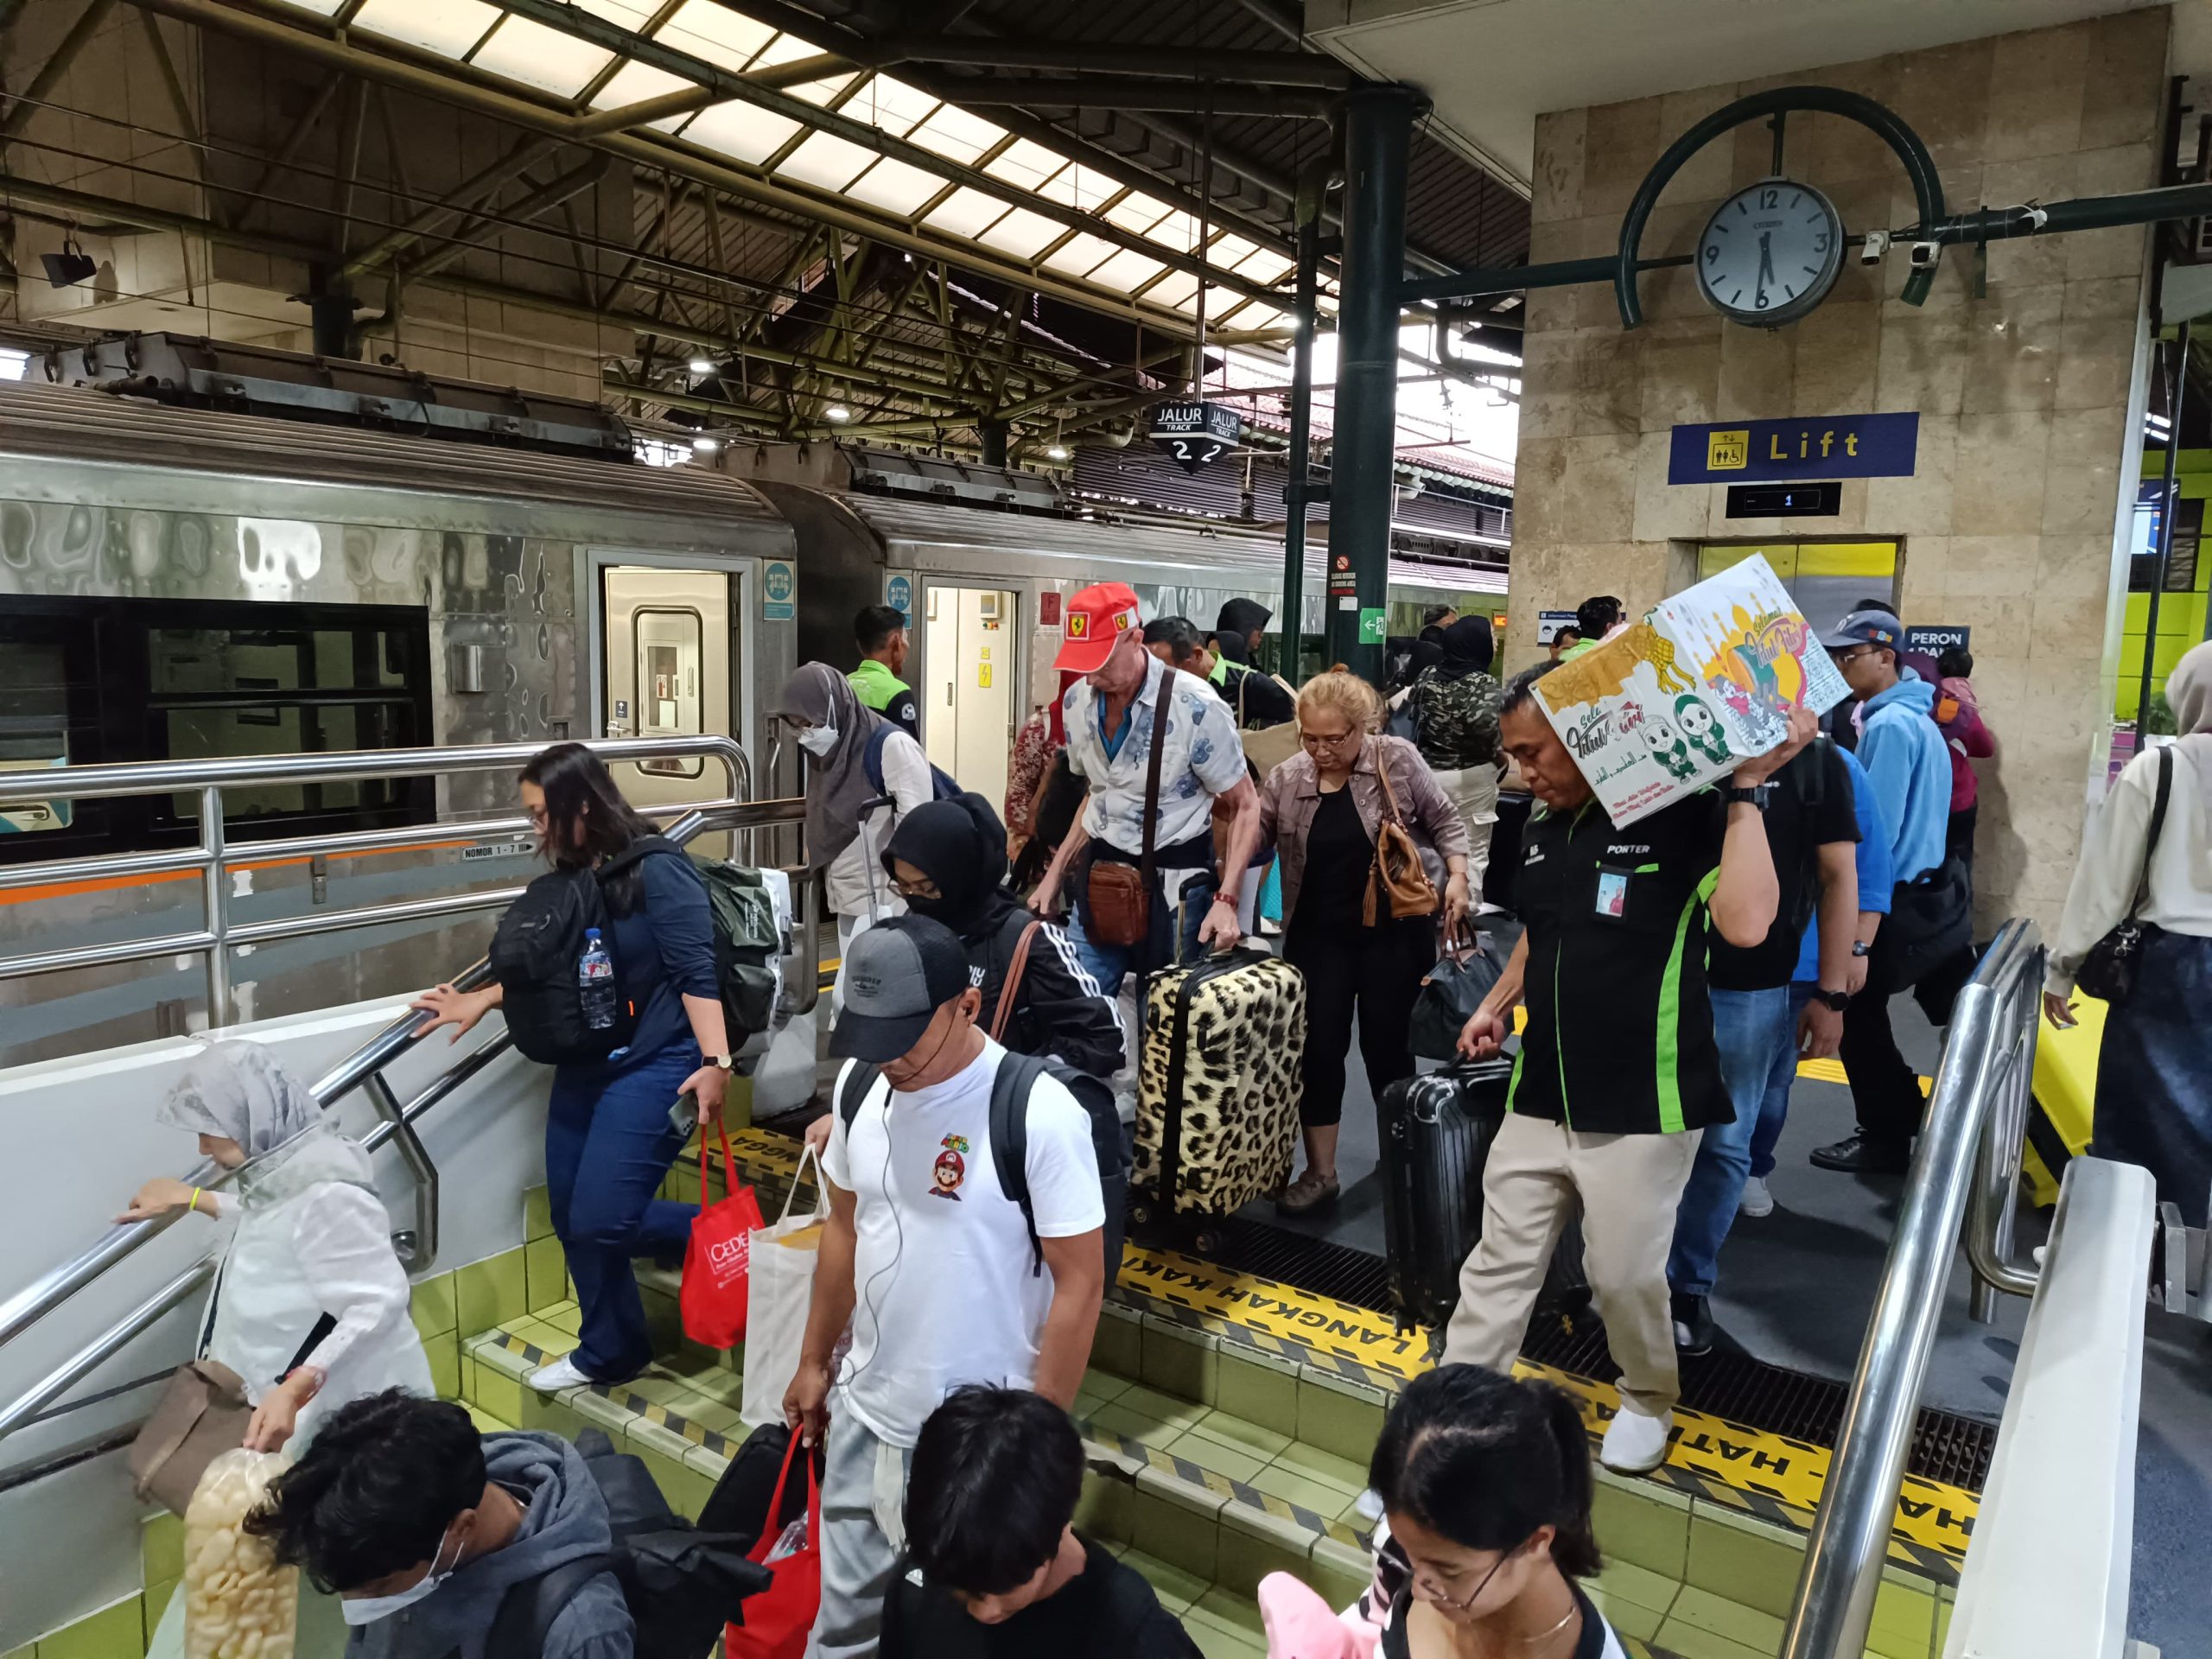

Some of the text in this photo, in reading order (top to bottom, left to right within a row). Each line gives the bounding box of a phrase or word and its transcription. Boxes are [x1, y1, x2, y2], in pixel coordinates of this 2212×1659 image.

[1759, 189, 1778, 210] 12
[1814, 233, 1827, 252] 3
[1706, 245, 1719, 265] 9
[1757, 289, 1770, 308] 6
[1158, 408, 1203, 422] JALUR
[1211, 410, 1237, 430] JALUR
[1216, 428, 1231, 437] TRACK
[1172, 441, 1192, 460] 2
[1201, 444, 1222, 462] 2
[1770, 430, 1859, 460] Lift
[1910, 632, 1962, 645] PERON
[465, 847, 493, 858] NOMOR
[497, 846, 501, 855] 1
[1607, 844, 1650, 854] PORTER
[941, 1138, 969, 1154] MARIO
[710, 1232, 749, 1262] CEDE
[1122, 1256, 1214, 1291] KAKI
[1217, 1281, 1413, 1354] LANGKAH
[1899, 1495, 1975, 1536] HA
